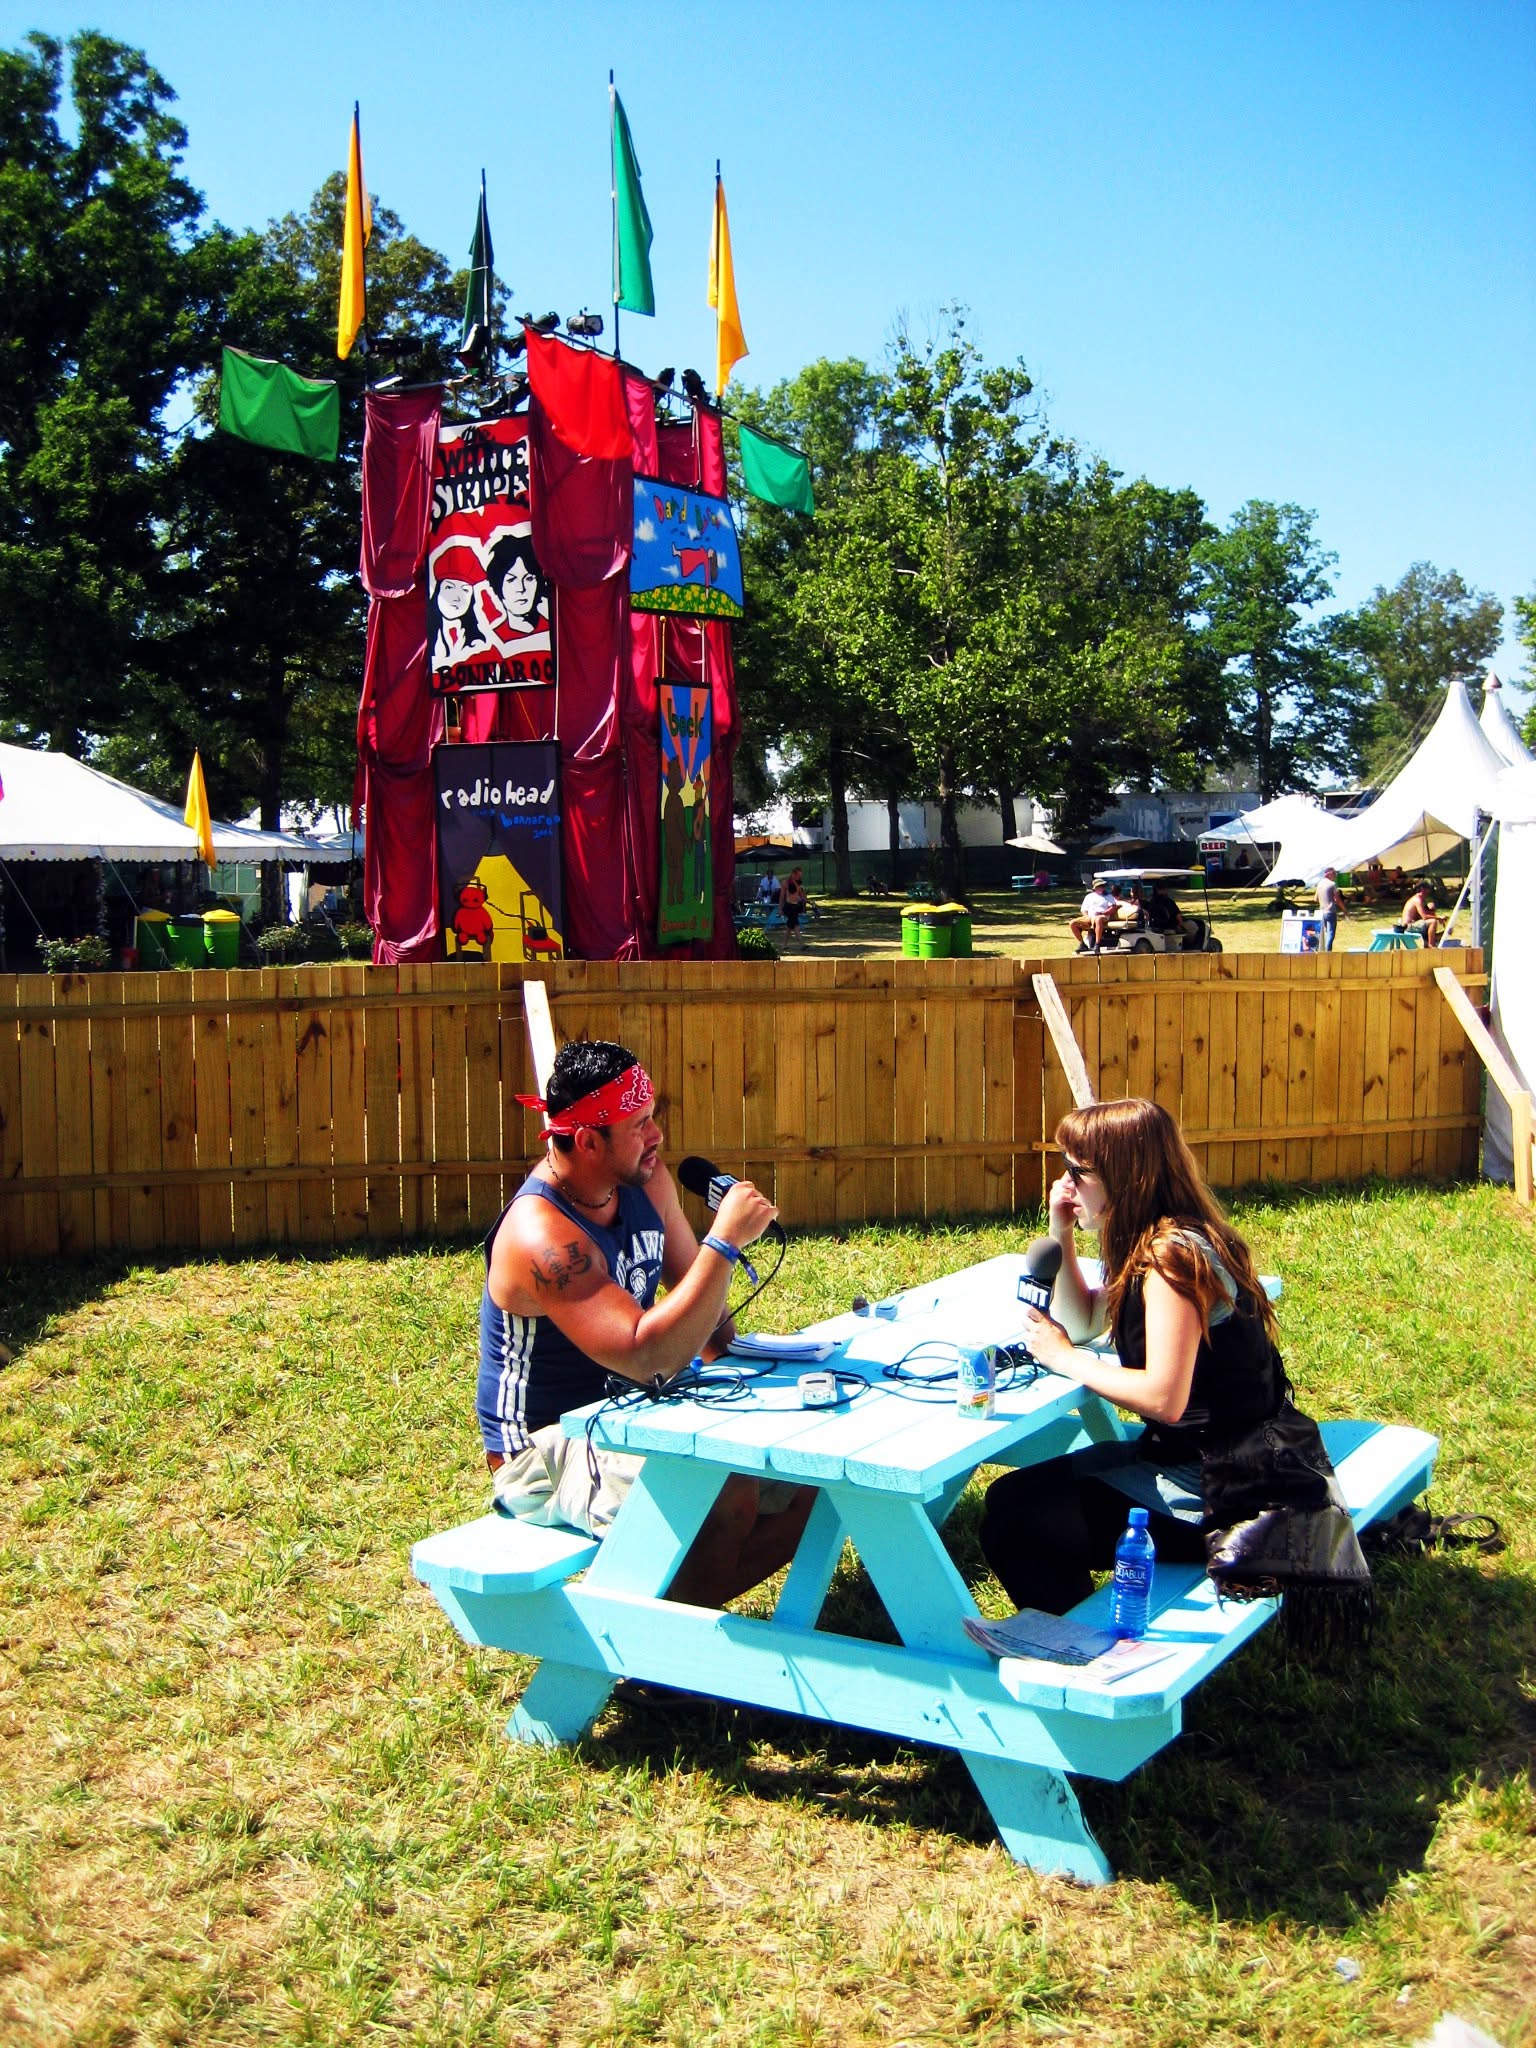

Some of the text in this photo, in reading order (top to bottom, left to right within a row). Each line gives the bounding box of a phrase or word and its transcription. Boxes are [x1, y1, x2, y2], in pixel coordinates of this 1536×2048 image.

[436, 657, 553, 689] BONNAROO
[666, 698, 705, 739] beck
[441, 777, 555, 809] radiohead
[1201, 842, 1226, 851] BEER
